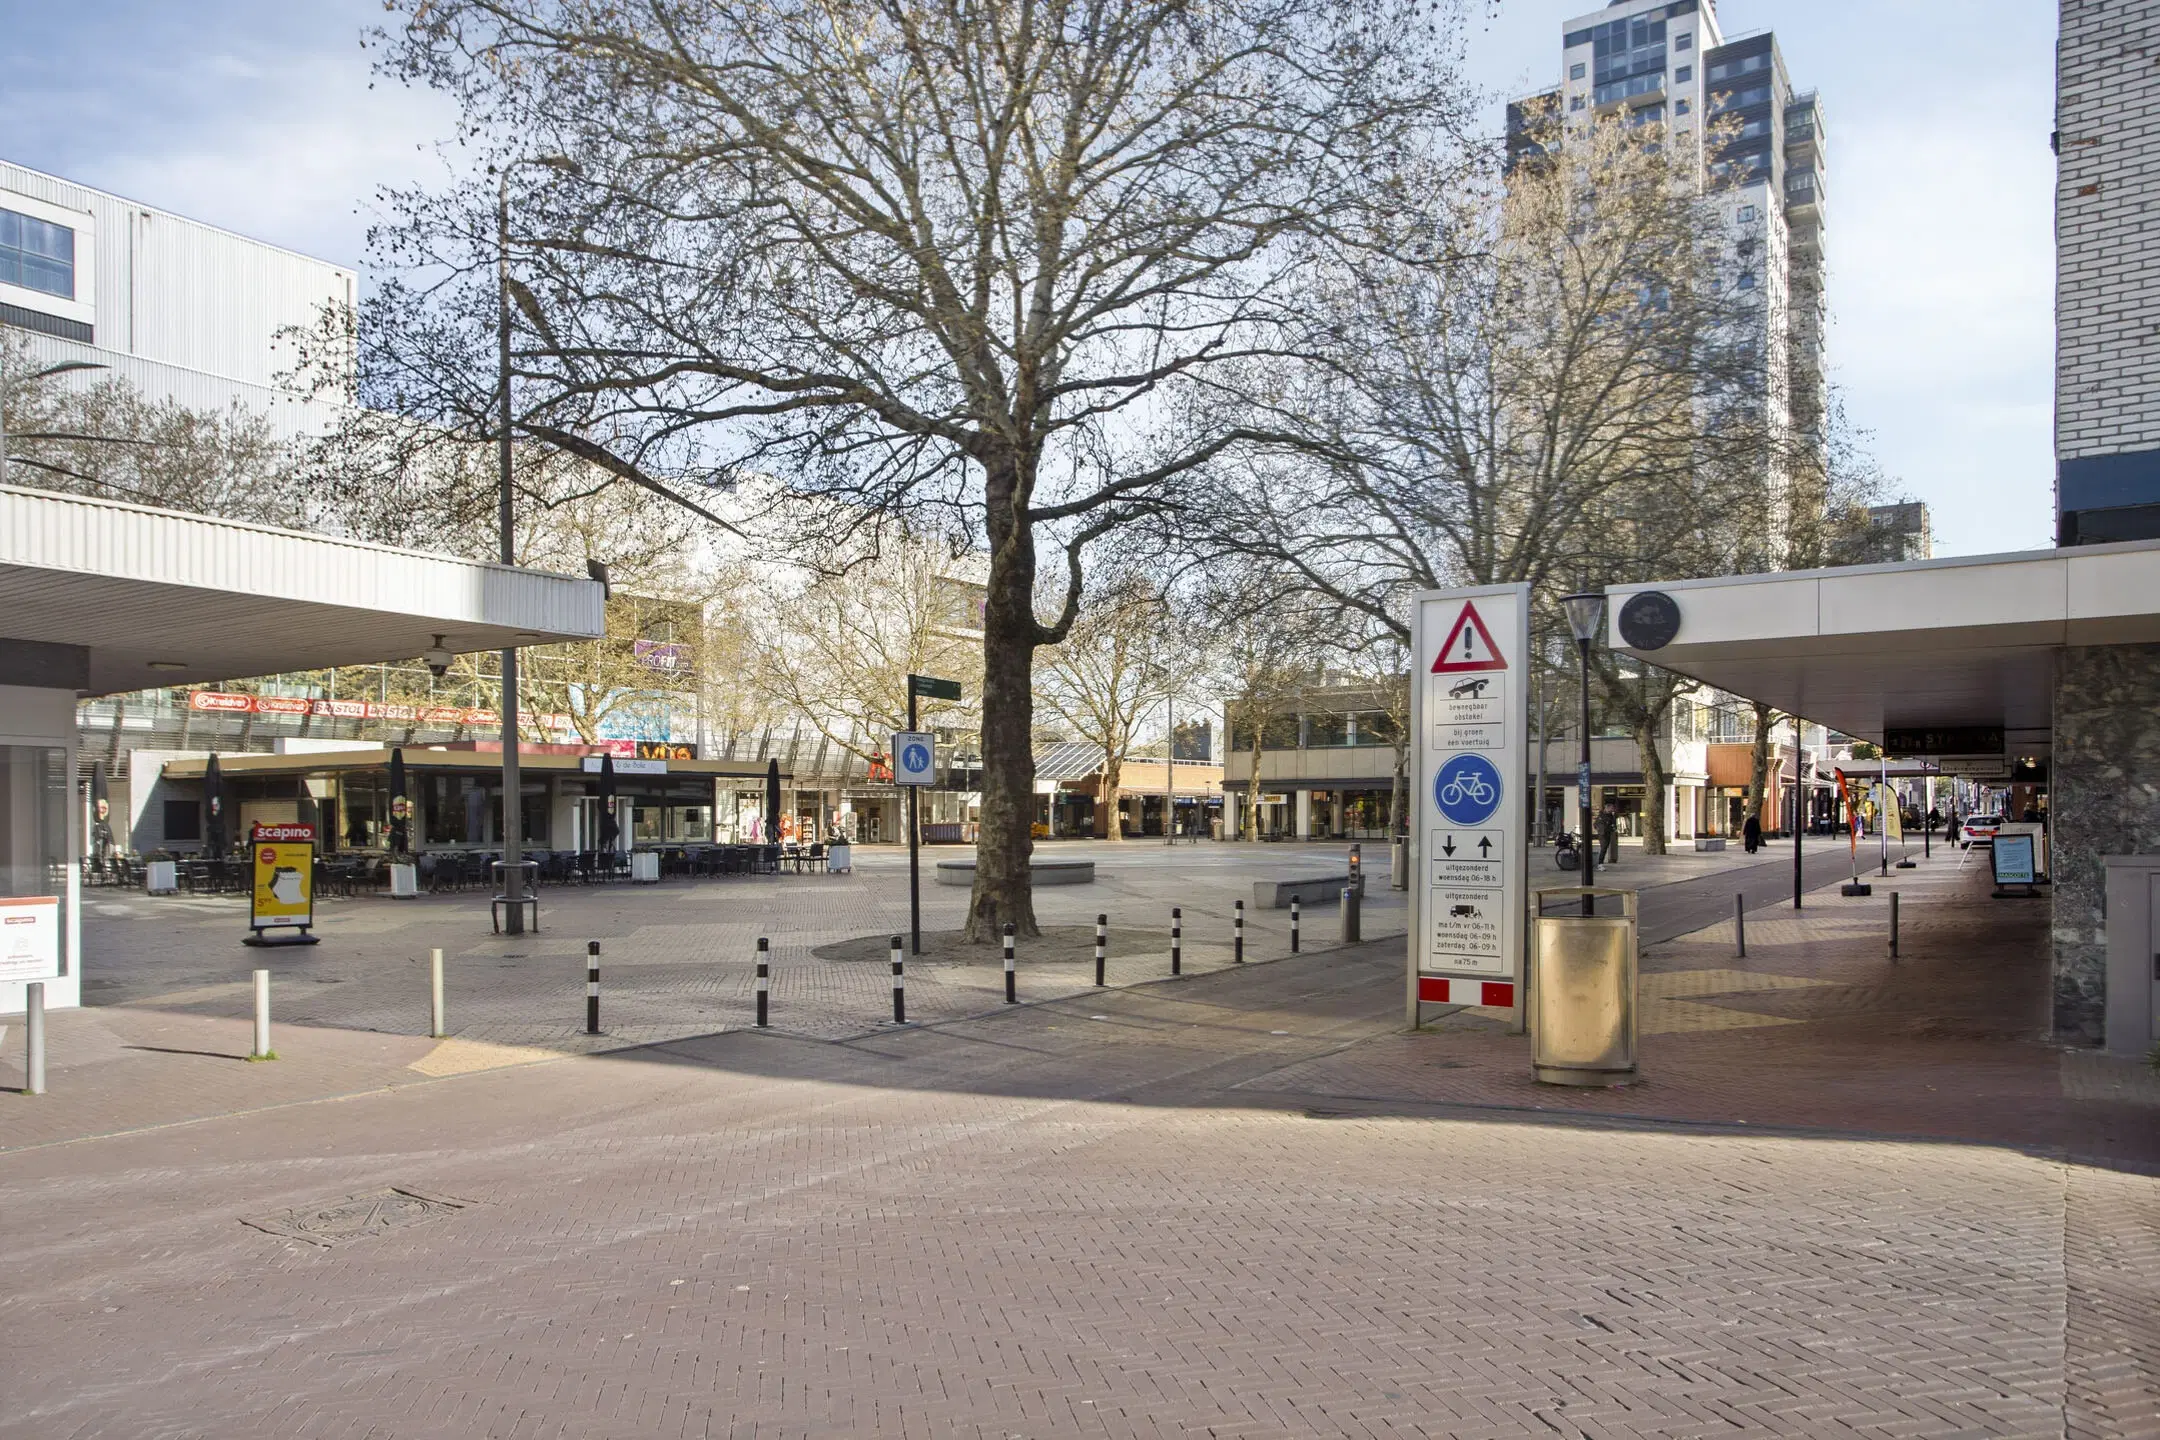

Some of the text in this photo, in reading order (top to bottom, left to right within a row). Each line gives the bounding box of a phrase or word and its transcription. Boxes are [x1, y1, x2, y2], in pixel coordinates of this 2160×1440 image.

[316, 703, 361, 714] BRISTOL
[1453, 729, 1462, 737] bij
[1461, 738, 1490, 746] voertuig
[257, 827, 311, 840] scapino
[1446, 864, 1489, 872] uitgezonderd
[1438, 874, 1470, 882] woensdag
[1445, 892, 1489, 901] uitgezonderd
[1449, 921, 1461, 929] t/m
[1437, 932, 1468, 940] woensdag
[1470, 932, 1491, 940] 06-09
[1437, 942, 1466, 950] zaterdag
[1469, 942, 1491, 950] 06-09
